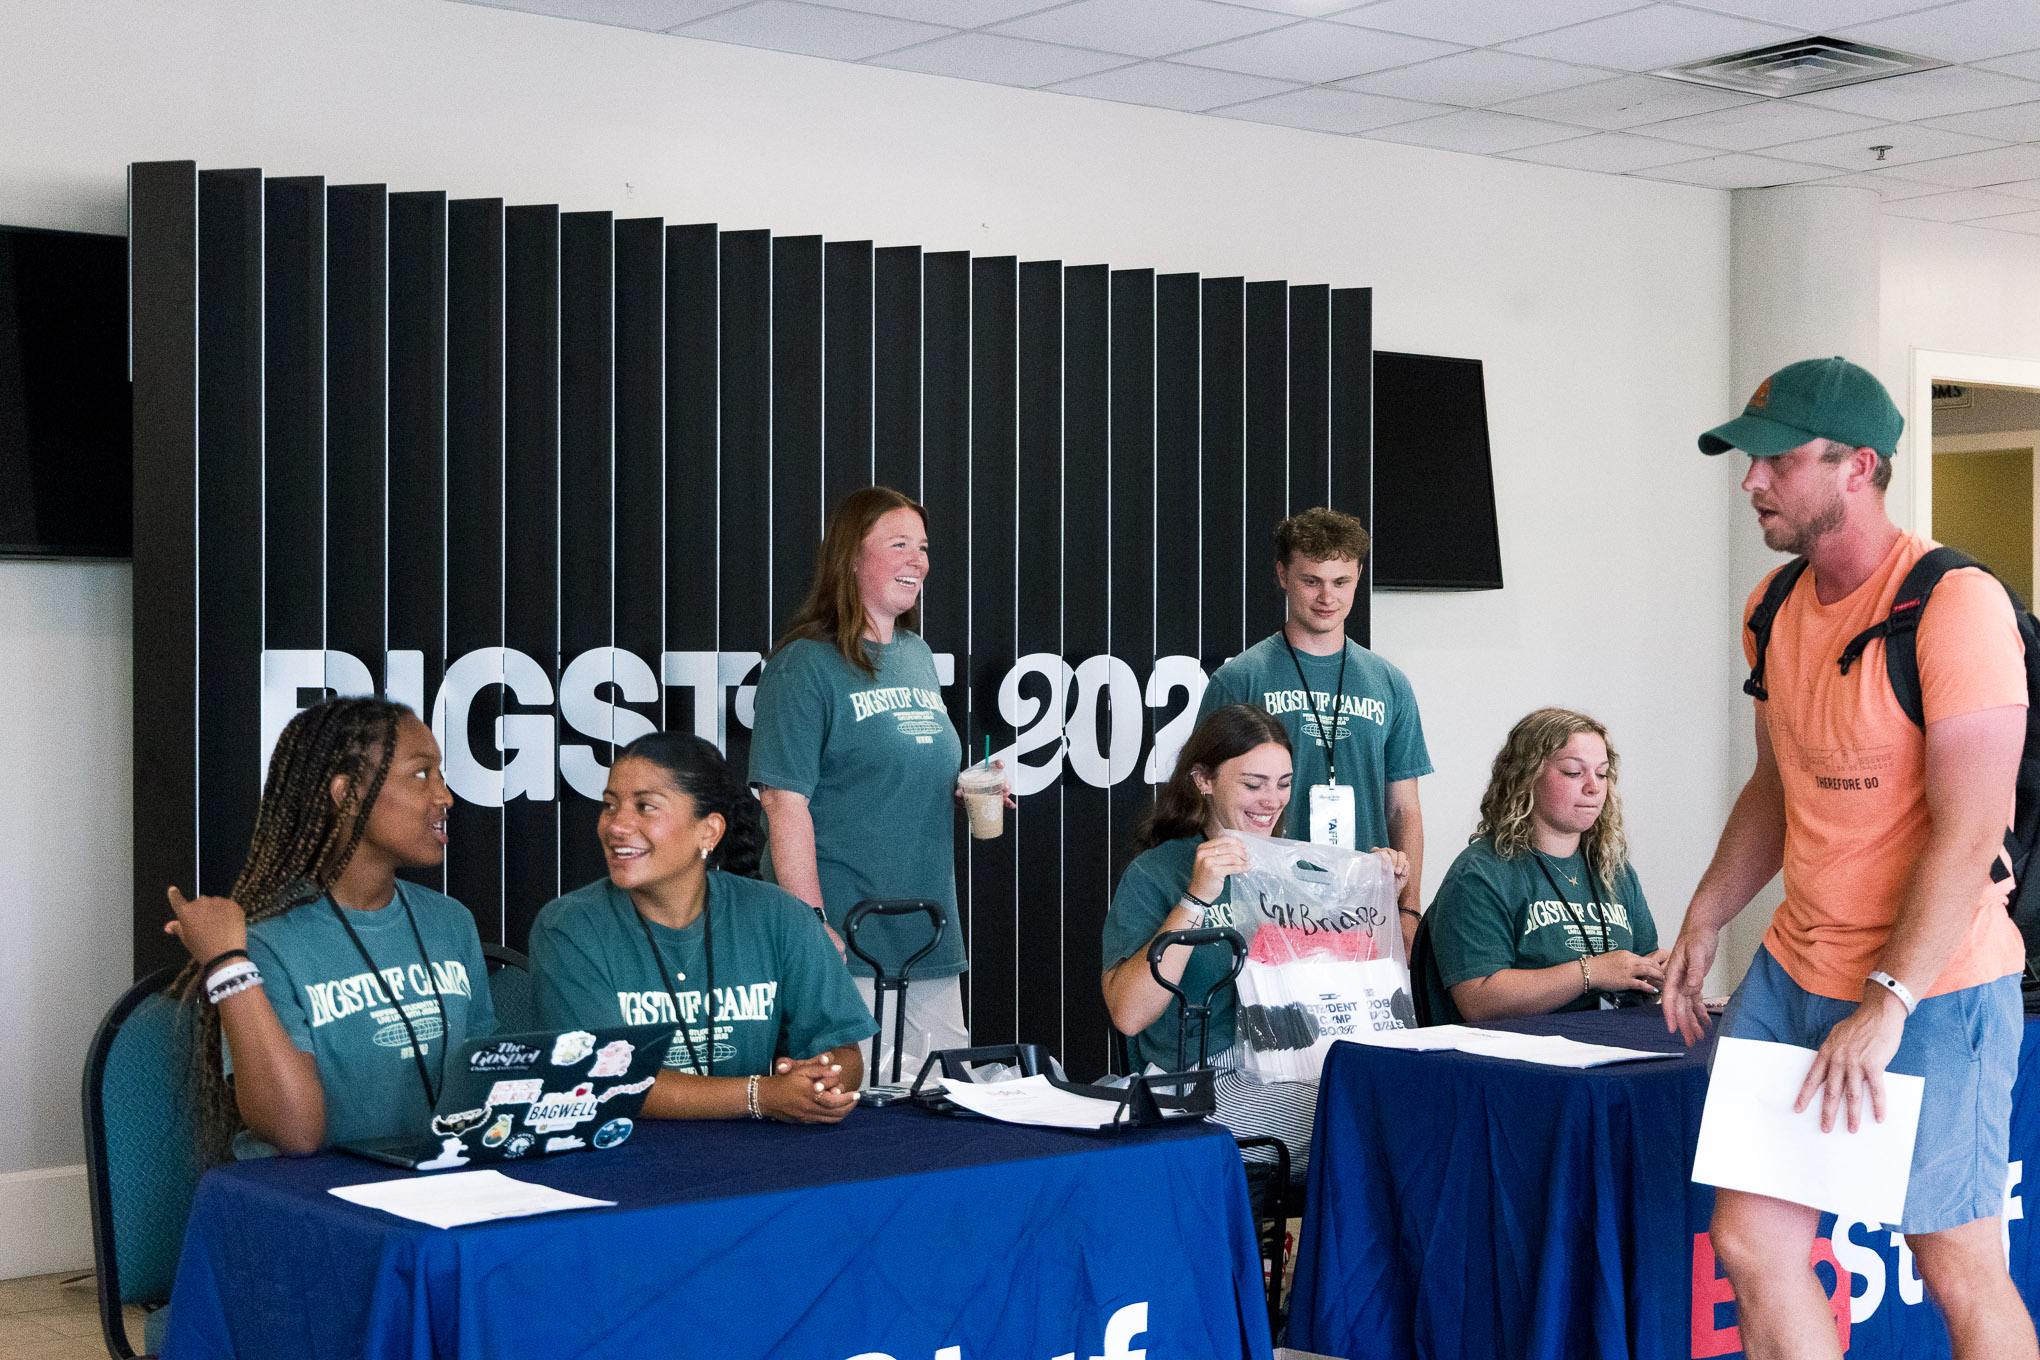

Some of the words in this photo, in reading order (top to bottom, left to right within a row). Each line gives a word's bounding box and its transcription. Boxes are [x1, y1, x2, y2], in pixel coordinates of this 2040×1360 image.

[849, 687, 912, 722] BIGSTUF
[1264, 690, 1330, 716] BIGSTUF
[1332, 694, 1385, 726] CAMPS
[967, 652, 1234, 796] 202
[1815, 775, 1862, 791] THEREFORE
[1864, 776, 1879, 789] GO
[1587, 902, 1633, 936] CAMP
[305, 967, 405, 1028] BIGSTUF
[617, 991, 701, 1026] IGSTUF
[470, 1049, 541, 1067] Gospel
[498, 1042, 526, 1053] The
[528, 1101, 597, 1121] BAGWELL
